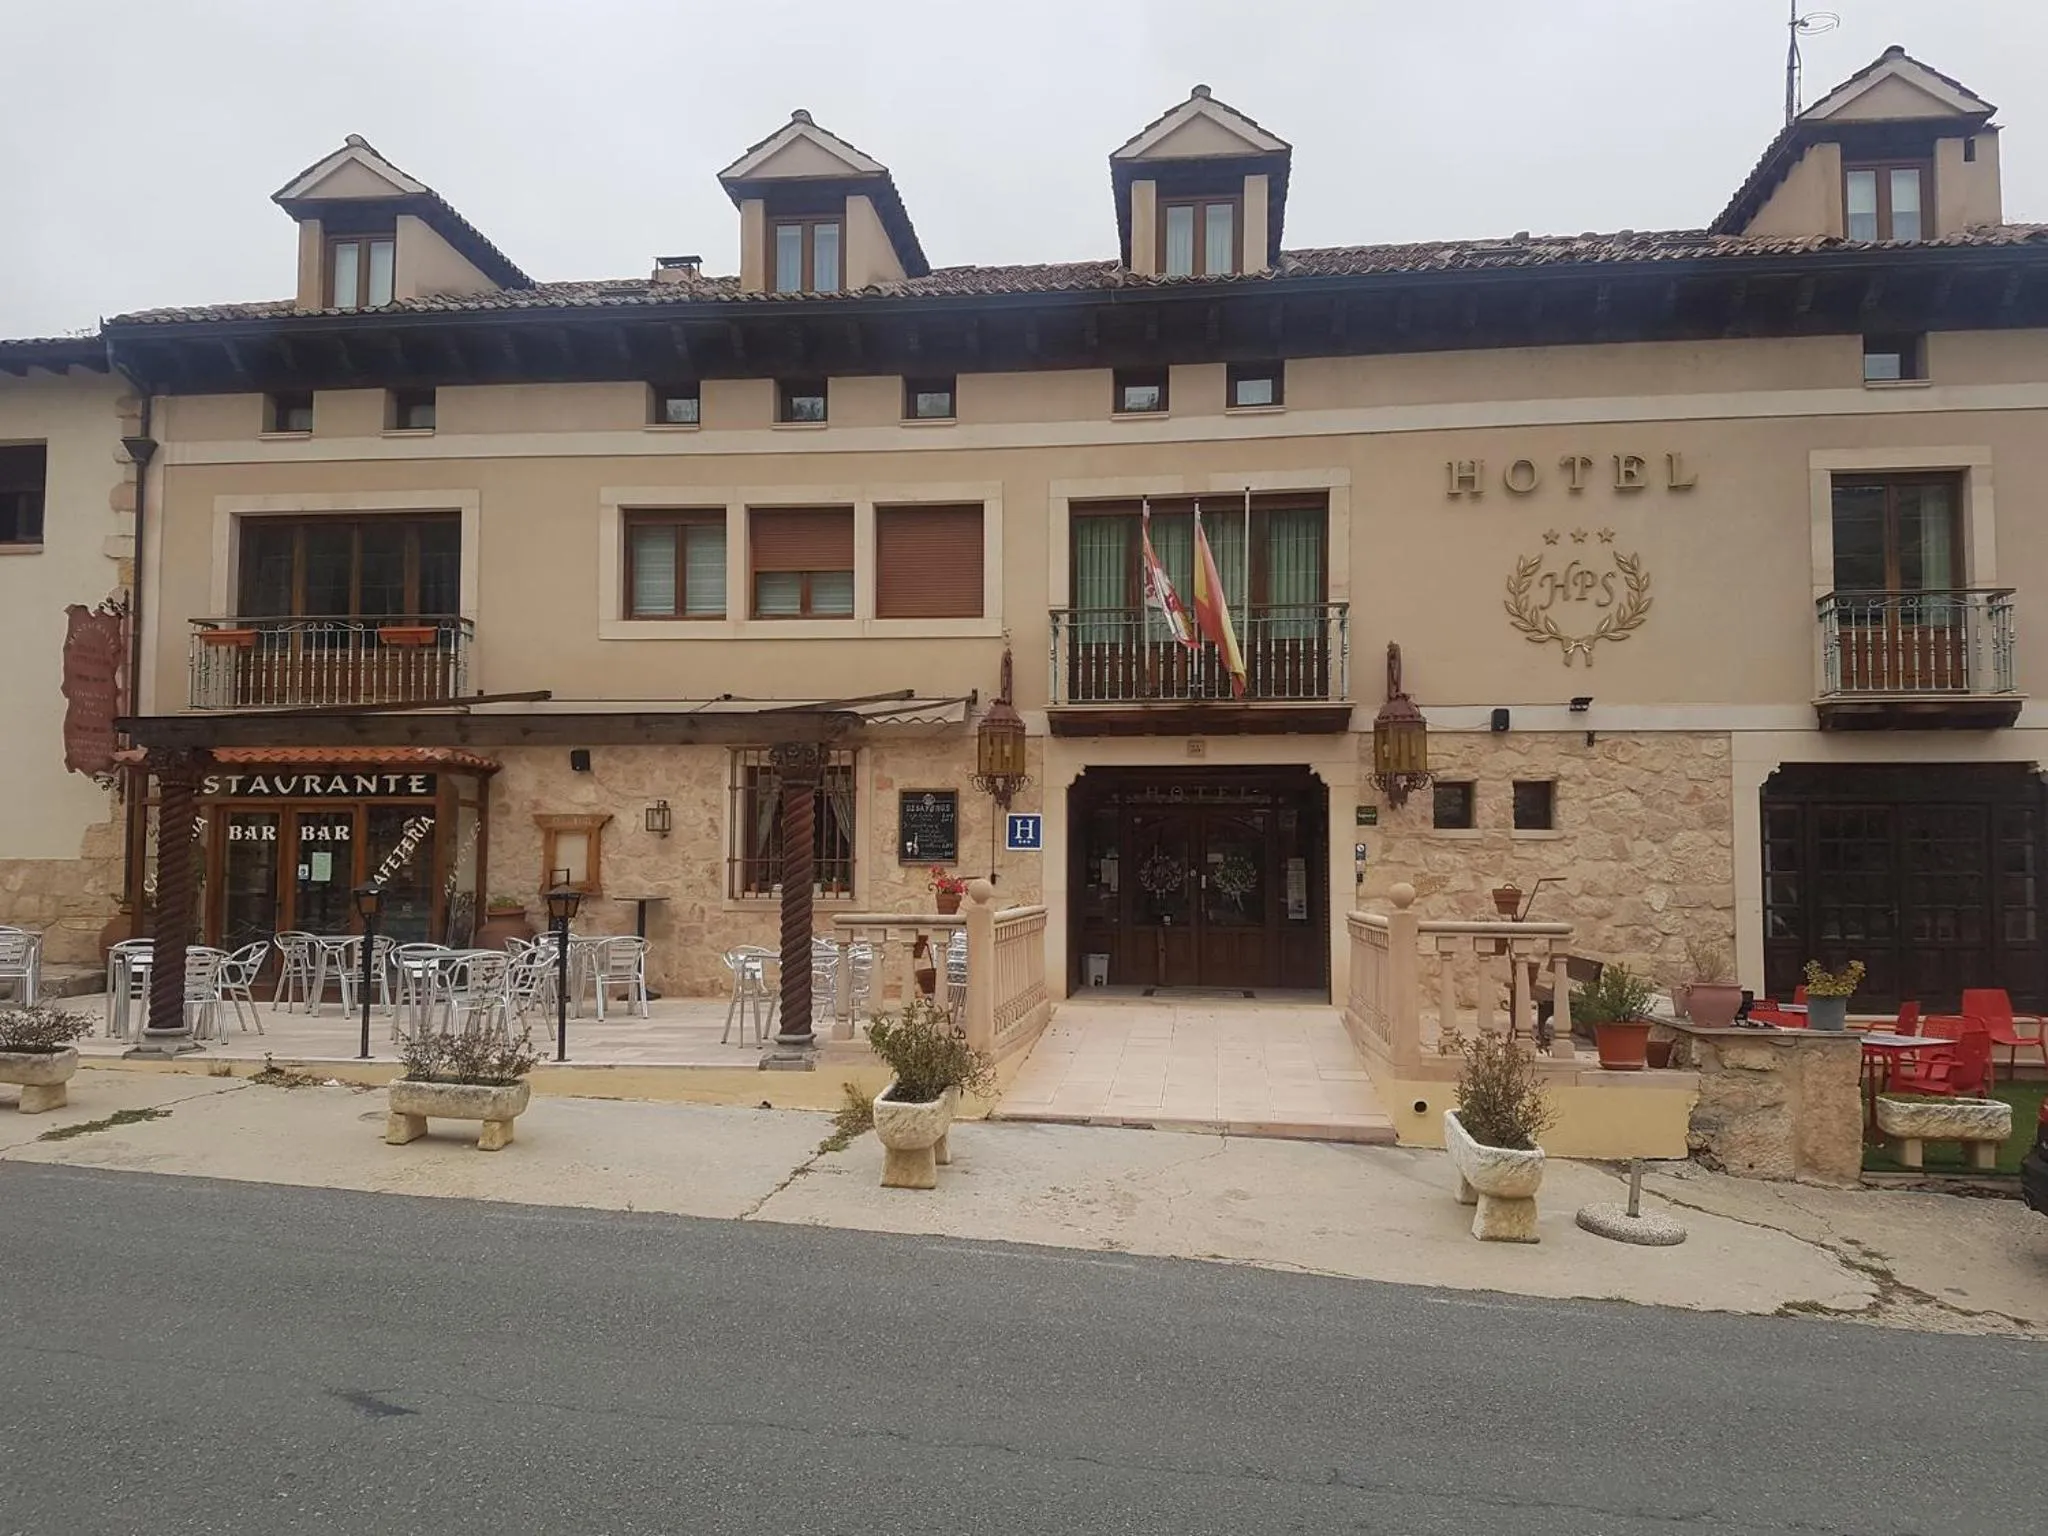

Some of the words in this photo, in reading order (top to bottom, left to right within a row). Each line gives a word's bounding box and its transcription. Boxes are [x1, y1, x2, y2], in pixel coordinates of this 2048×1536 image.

[1446, 453, 1698, 499] HOTEL
[1538, 560, 1617, 610] HPS
[194, 775, 428, 795] STAURANTE
[228, 825, 277, 841] BAR
[300, 825, 350, 841] BAR
[1015, 819, 1035, 839] H
[372, 815, 435, 886] AFETERIA
